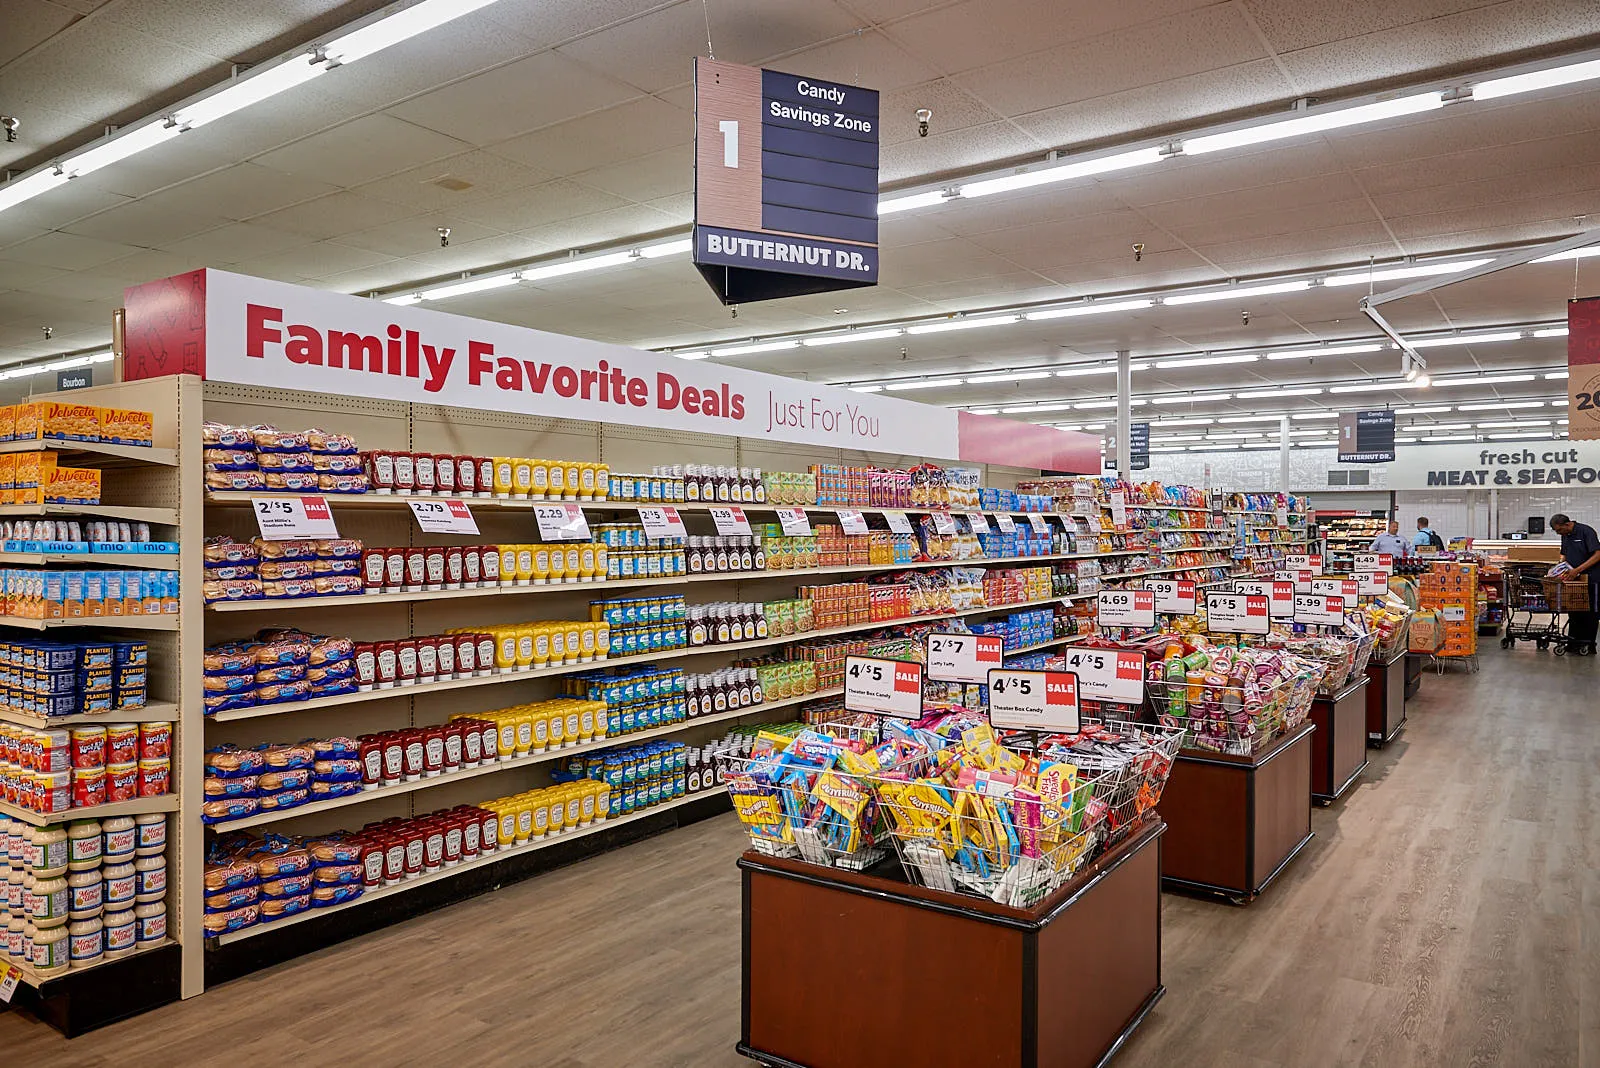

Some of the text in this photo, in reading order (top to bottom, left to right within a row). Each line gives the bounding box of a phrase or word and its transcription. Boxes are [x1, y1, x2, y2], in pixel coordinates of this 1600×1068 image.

[797, 81, 845, 105] Candy
[770, 101, 872, 133] Savings Zone
[719, 120, 738, 168] 1
[707, 234, 870, 272] BUTTERNUT DR.
[246, 303, 745, 420] Family Favorite Deals
[62, 377, 86, 388] Bourbon
[49, 403, 95, 418] Velveeta
[105, 409, 148, 424] Velveeta
[766, 390, 879, 437] Just For You
[1344, 426, 1351, 439] 1
[1108, 437, 1117, 449] 2
[1479, 448, 1578, 465] fresh cut
[49, 468, 95, 484] Velveeta
[1427, 467, 1600, 486] MEAT & SEAFO
[258, 501, 293, 514] 2/$5
[413, 503, 444, 513] 2.79
[538, 509, 563, 519] 2.29
[713, 510, 731, 519] 2.99
[1146, 583, 1172, 593] 6.99
[1237, 584, 1263, 595] 2/$5
[1313, 581, 1334, 590] 4/$5
[1100, 595, 1128, 605] 4.69
[1209, 598, 1236, 610] 4/$5
[1296, 598, 1321, 607] 5.99
[932, 638, 964, 653] 2/$7
[977, 644, 1000, 653] SALE
[1069, 653, 1104, 670] 4/$5
[1118, 660, 1142, 670] SALE
[849, 663, 882, 681] 4/$5
[895, 672, 919, 682] SALE
[992, 677, 1031, 695] 4/$5
[1047, 683, 1074, 693] SALE
[875, 691, 891, 699] Candy
